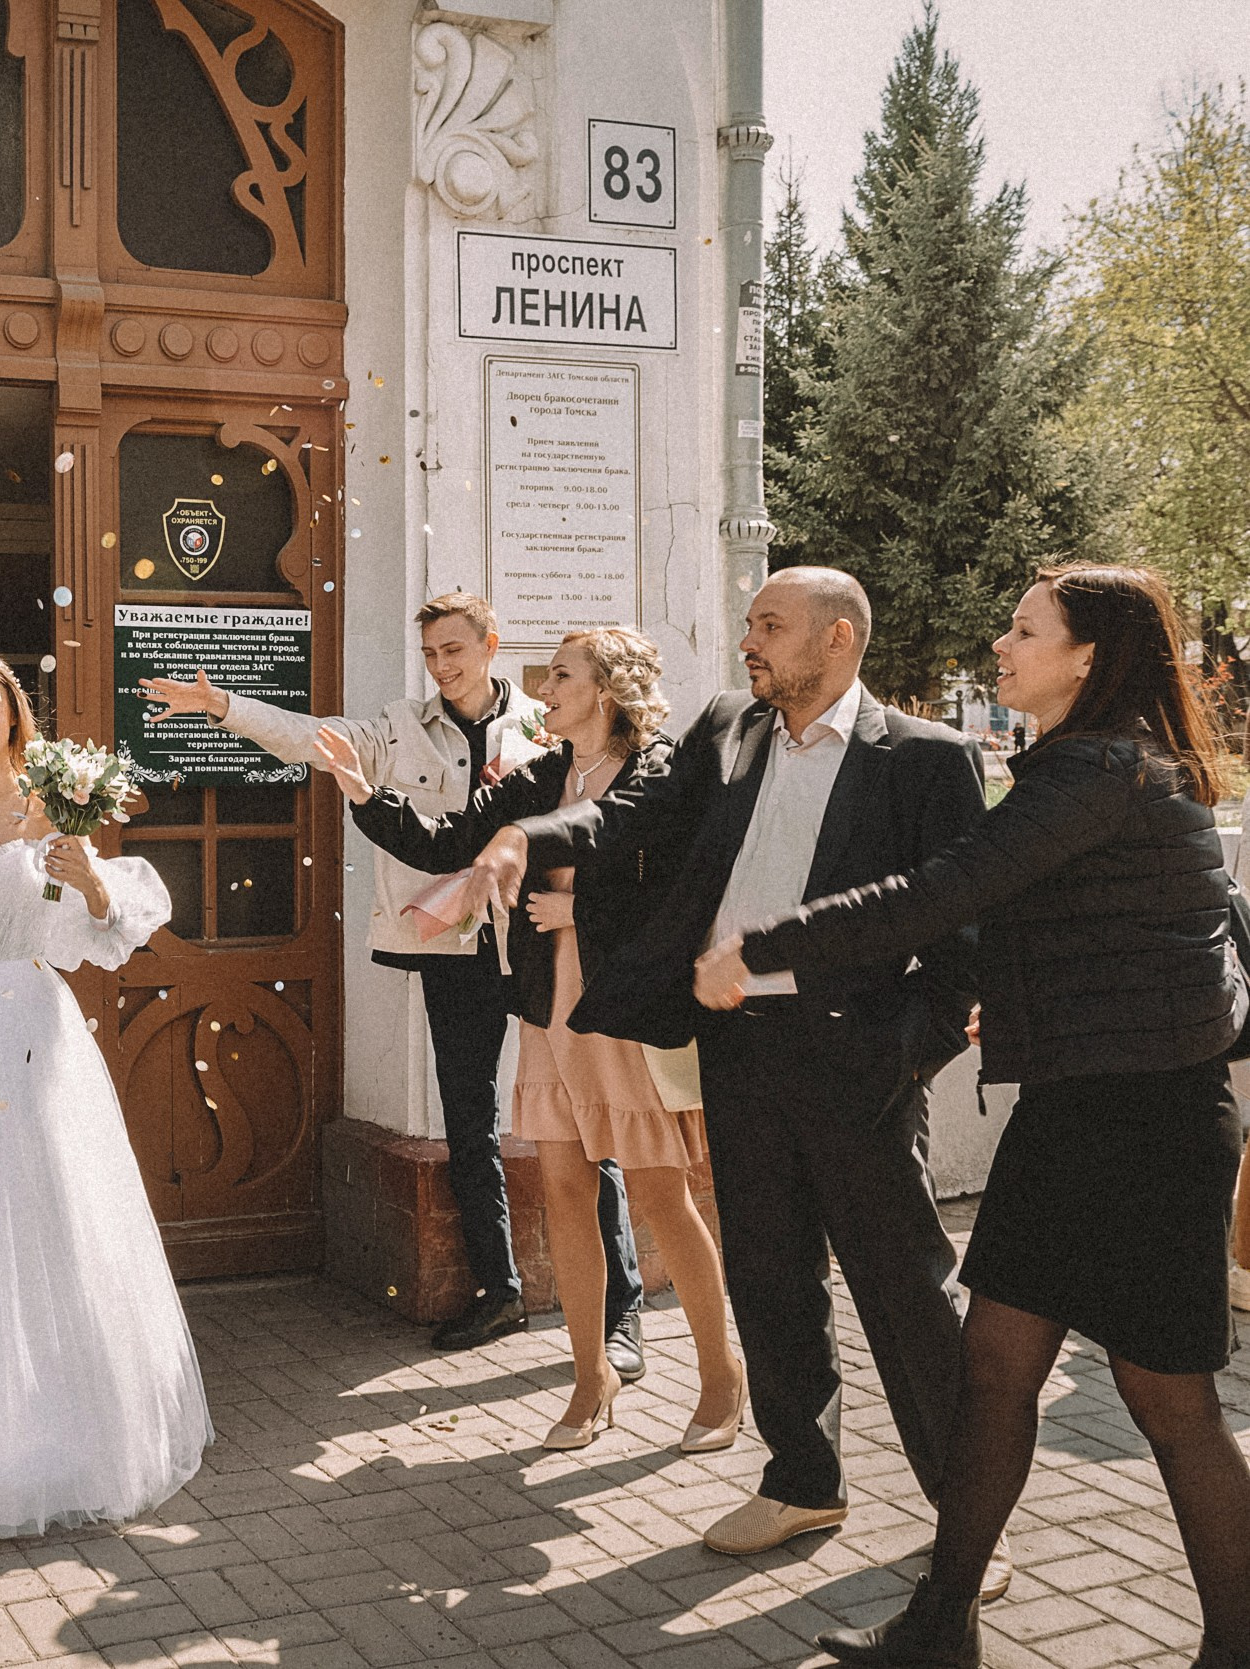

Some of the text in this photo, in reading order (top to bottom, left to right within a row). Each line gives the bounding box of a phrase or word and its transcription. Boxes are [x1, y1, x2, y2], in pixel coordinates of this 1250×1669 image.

[603, 145, 662, 204] 83
[511, 252, 624, 279] проспект
[492, 286, 647, 332] ЛЕНИНА
[496, 370, 544, 379] Департамент
[600, 375, 629, 383] области
[507, 392, 541, 403] Дворец
[530, 406, 597, 416] города Томска
[557, 438, 599, 448] заявлений
[534, 452, 606, 461] государственную
[495, 464, 550, 472] регистрацию
[520, 484, 554, 493] вторник
[501, 530, 626, 542] Государственная регистрация
[118, 610, 308, 627] Уважаемые граждане!
[132, 630, 150, 640] При
[153, 632, 210, 641] регистрации
[268, 633, 294, 643] брака
[164, 641, 220, 650] соблюдения
[143, 651, 193, 659] избежание
[168, 755, 261, 764] Заранее благодарим
